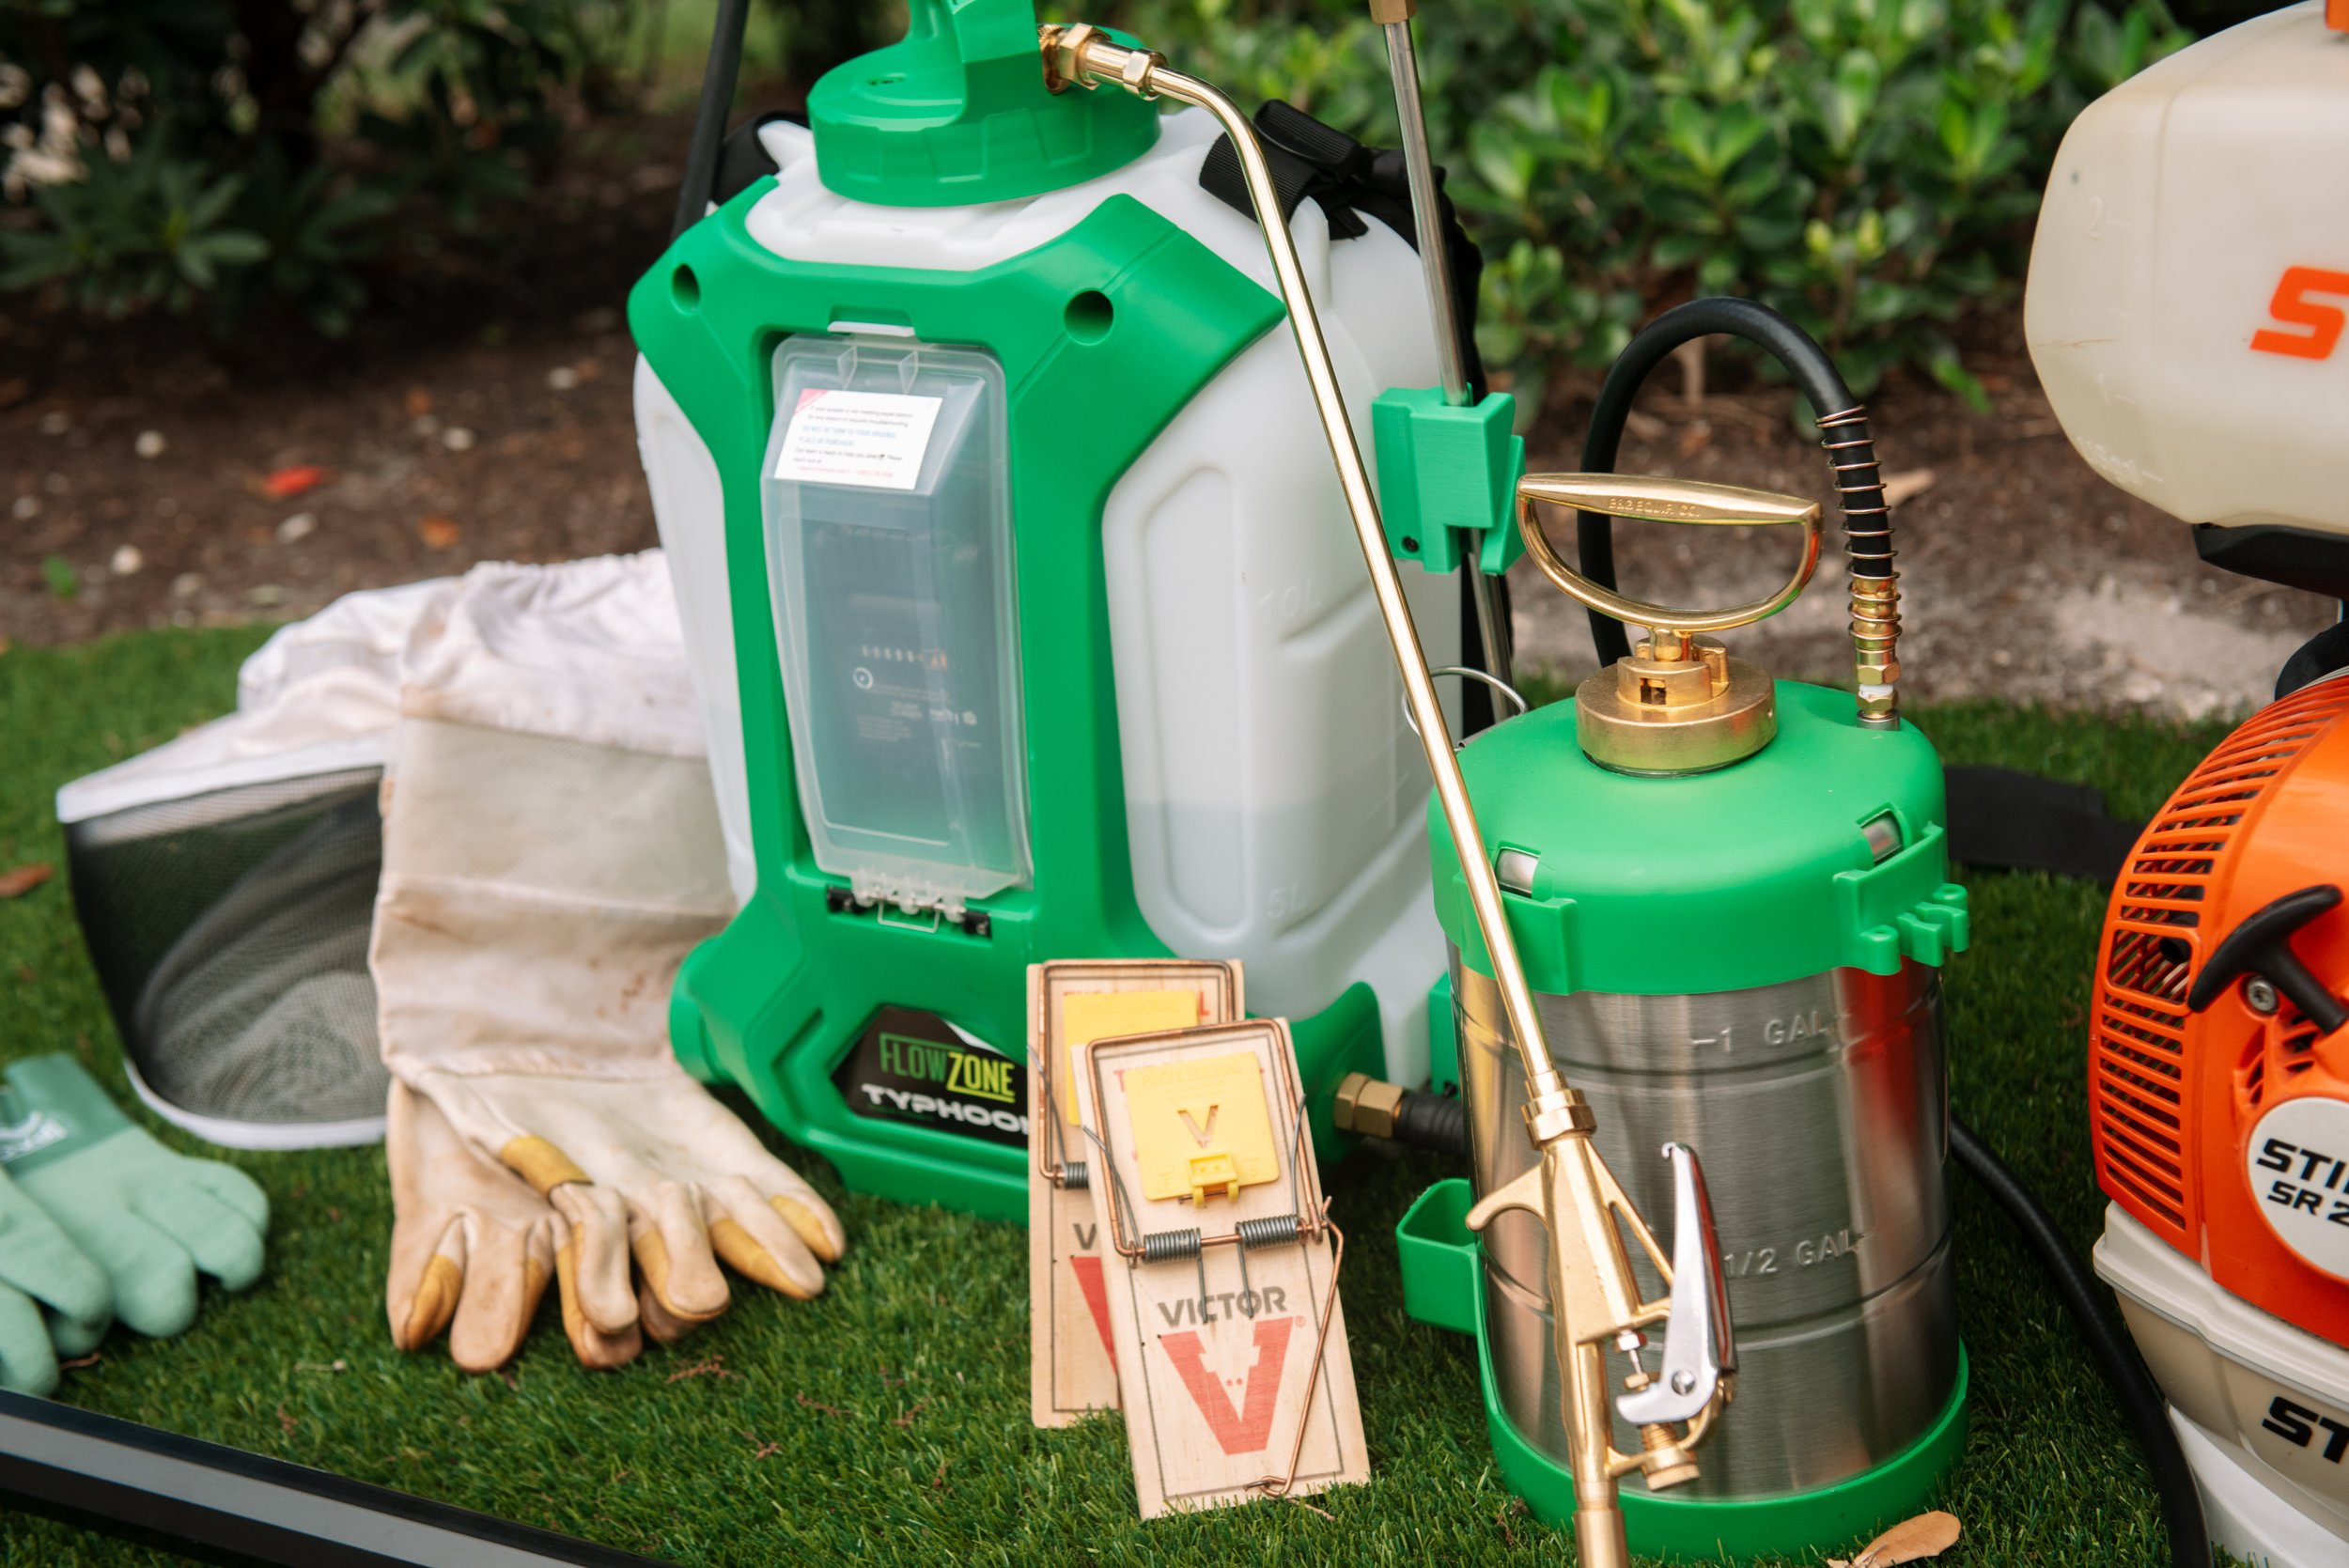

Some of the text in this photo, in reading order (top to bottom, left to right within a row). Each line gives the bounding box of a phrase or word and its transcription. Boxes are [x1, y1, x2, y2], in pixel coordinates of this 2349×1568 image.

[2257, 1138, 2349, 1195] STI
[2267, 1180, 2318, 1216] SR
[1157, 1286, 1287, 1328] VICTOR
